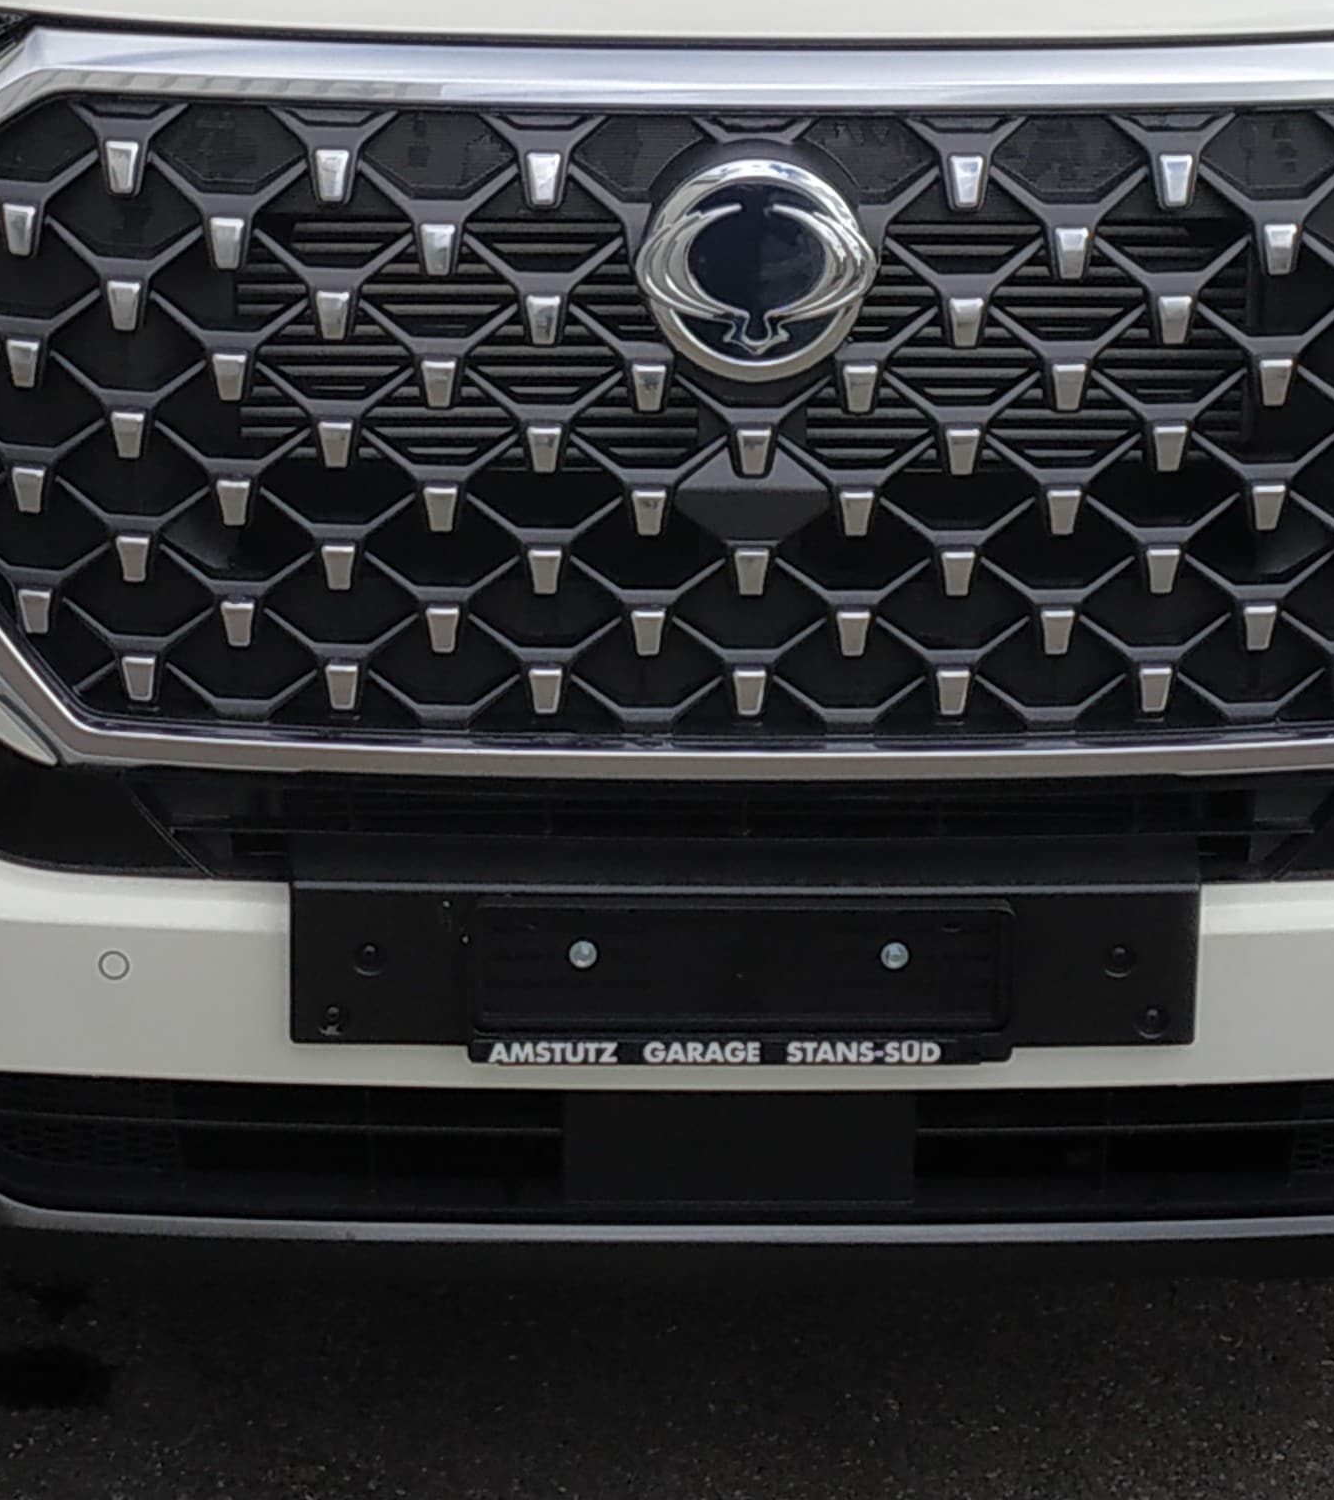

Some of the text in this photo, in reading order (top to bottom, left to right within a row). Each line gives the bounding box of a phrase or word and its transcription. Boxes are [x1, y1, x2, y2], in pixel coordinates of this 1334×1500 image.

[488, 1039, 942, 1063] AMSTUTZ GARAGE STANS-SÜD
